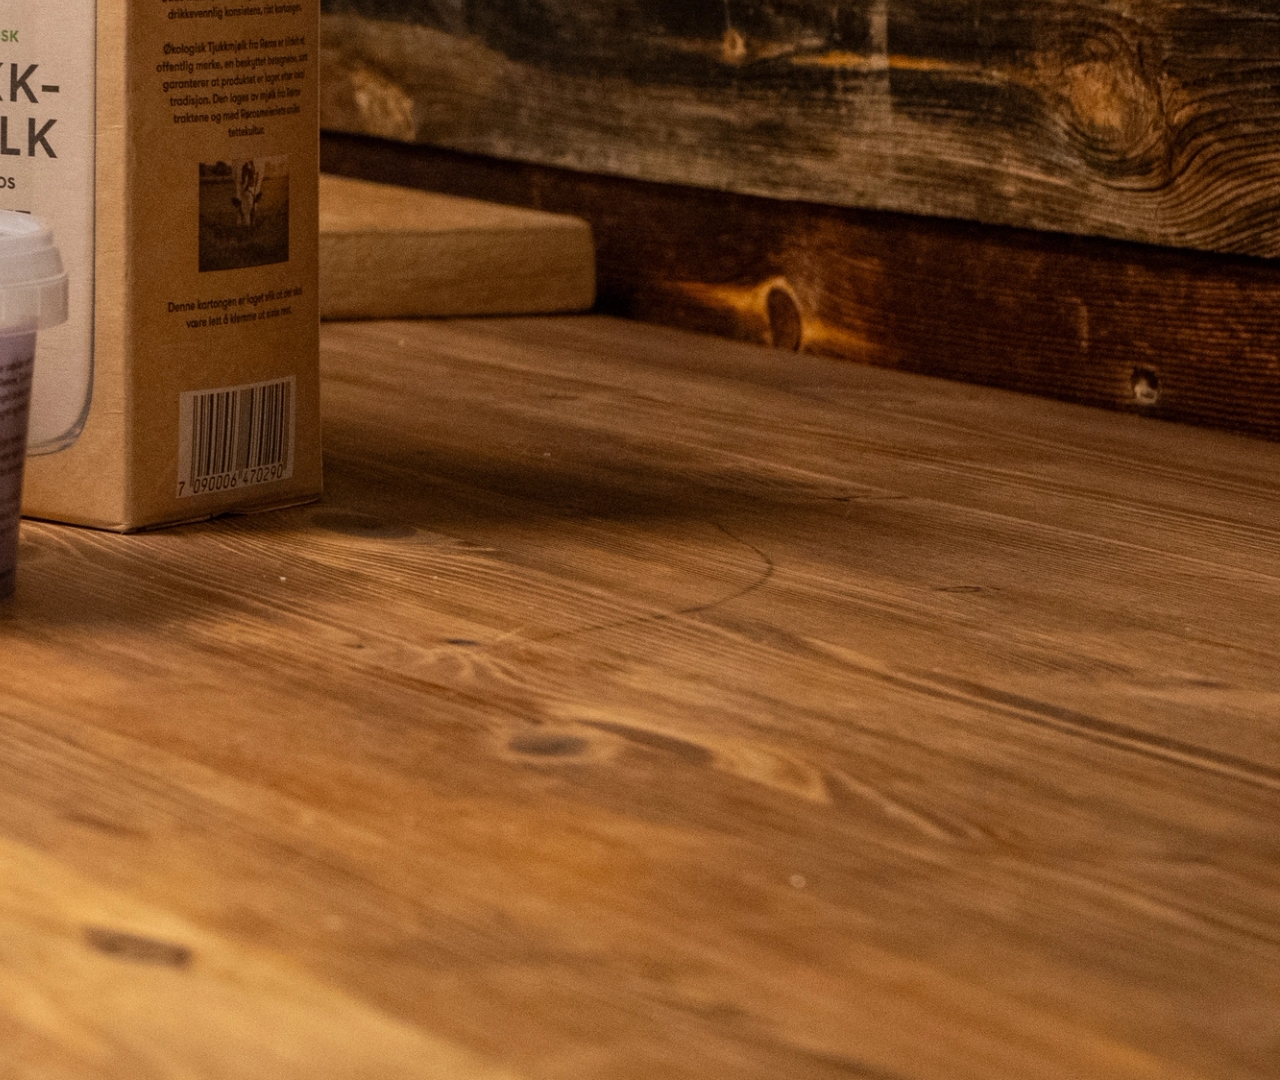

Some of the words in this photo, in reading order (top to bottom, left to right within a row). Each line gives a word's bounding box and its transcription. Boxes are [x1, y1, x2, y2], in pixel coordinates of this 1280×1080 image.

[163, 43, 205, 55] Økologisk
[168, 302, 195, 313] Denne
[178, 481, 186, 496] 7
[193, 474, 237, 494] 090006
[242, 464, 283, 484] 470290
